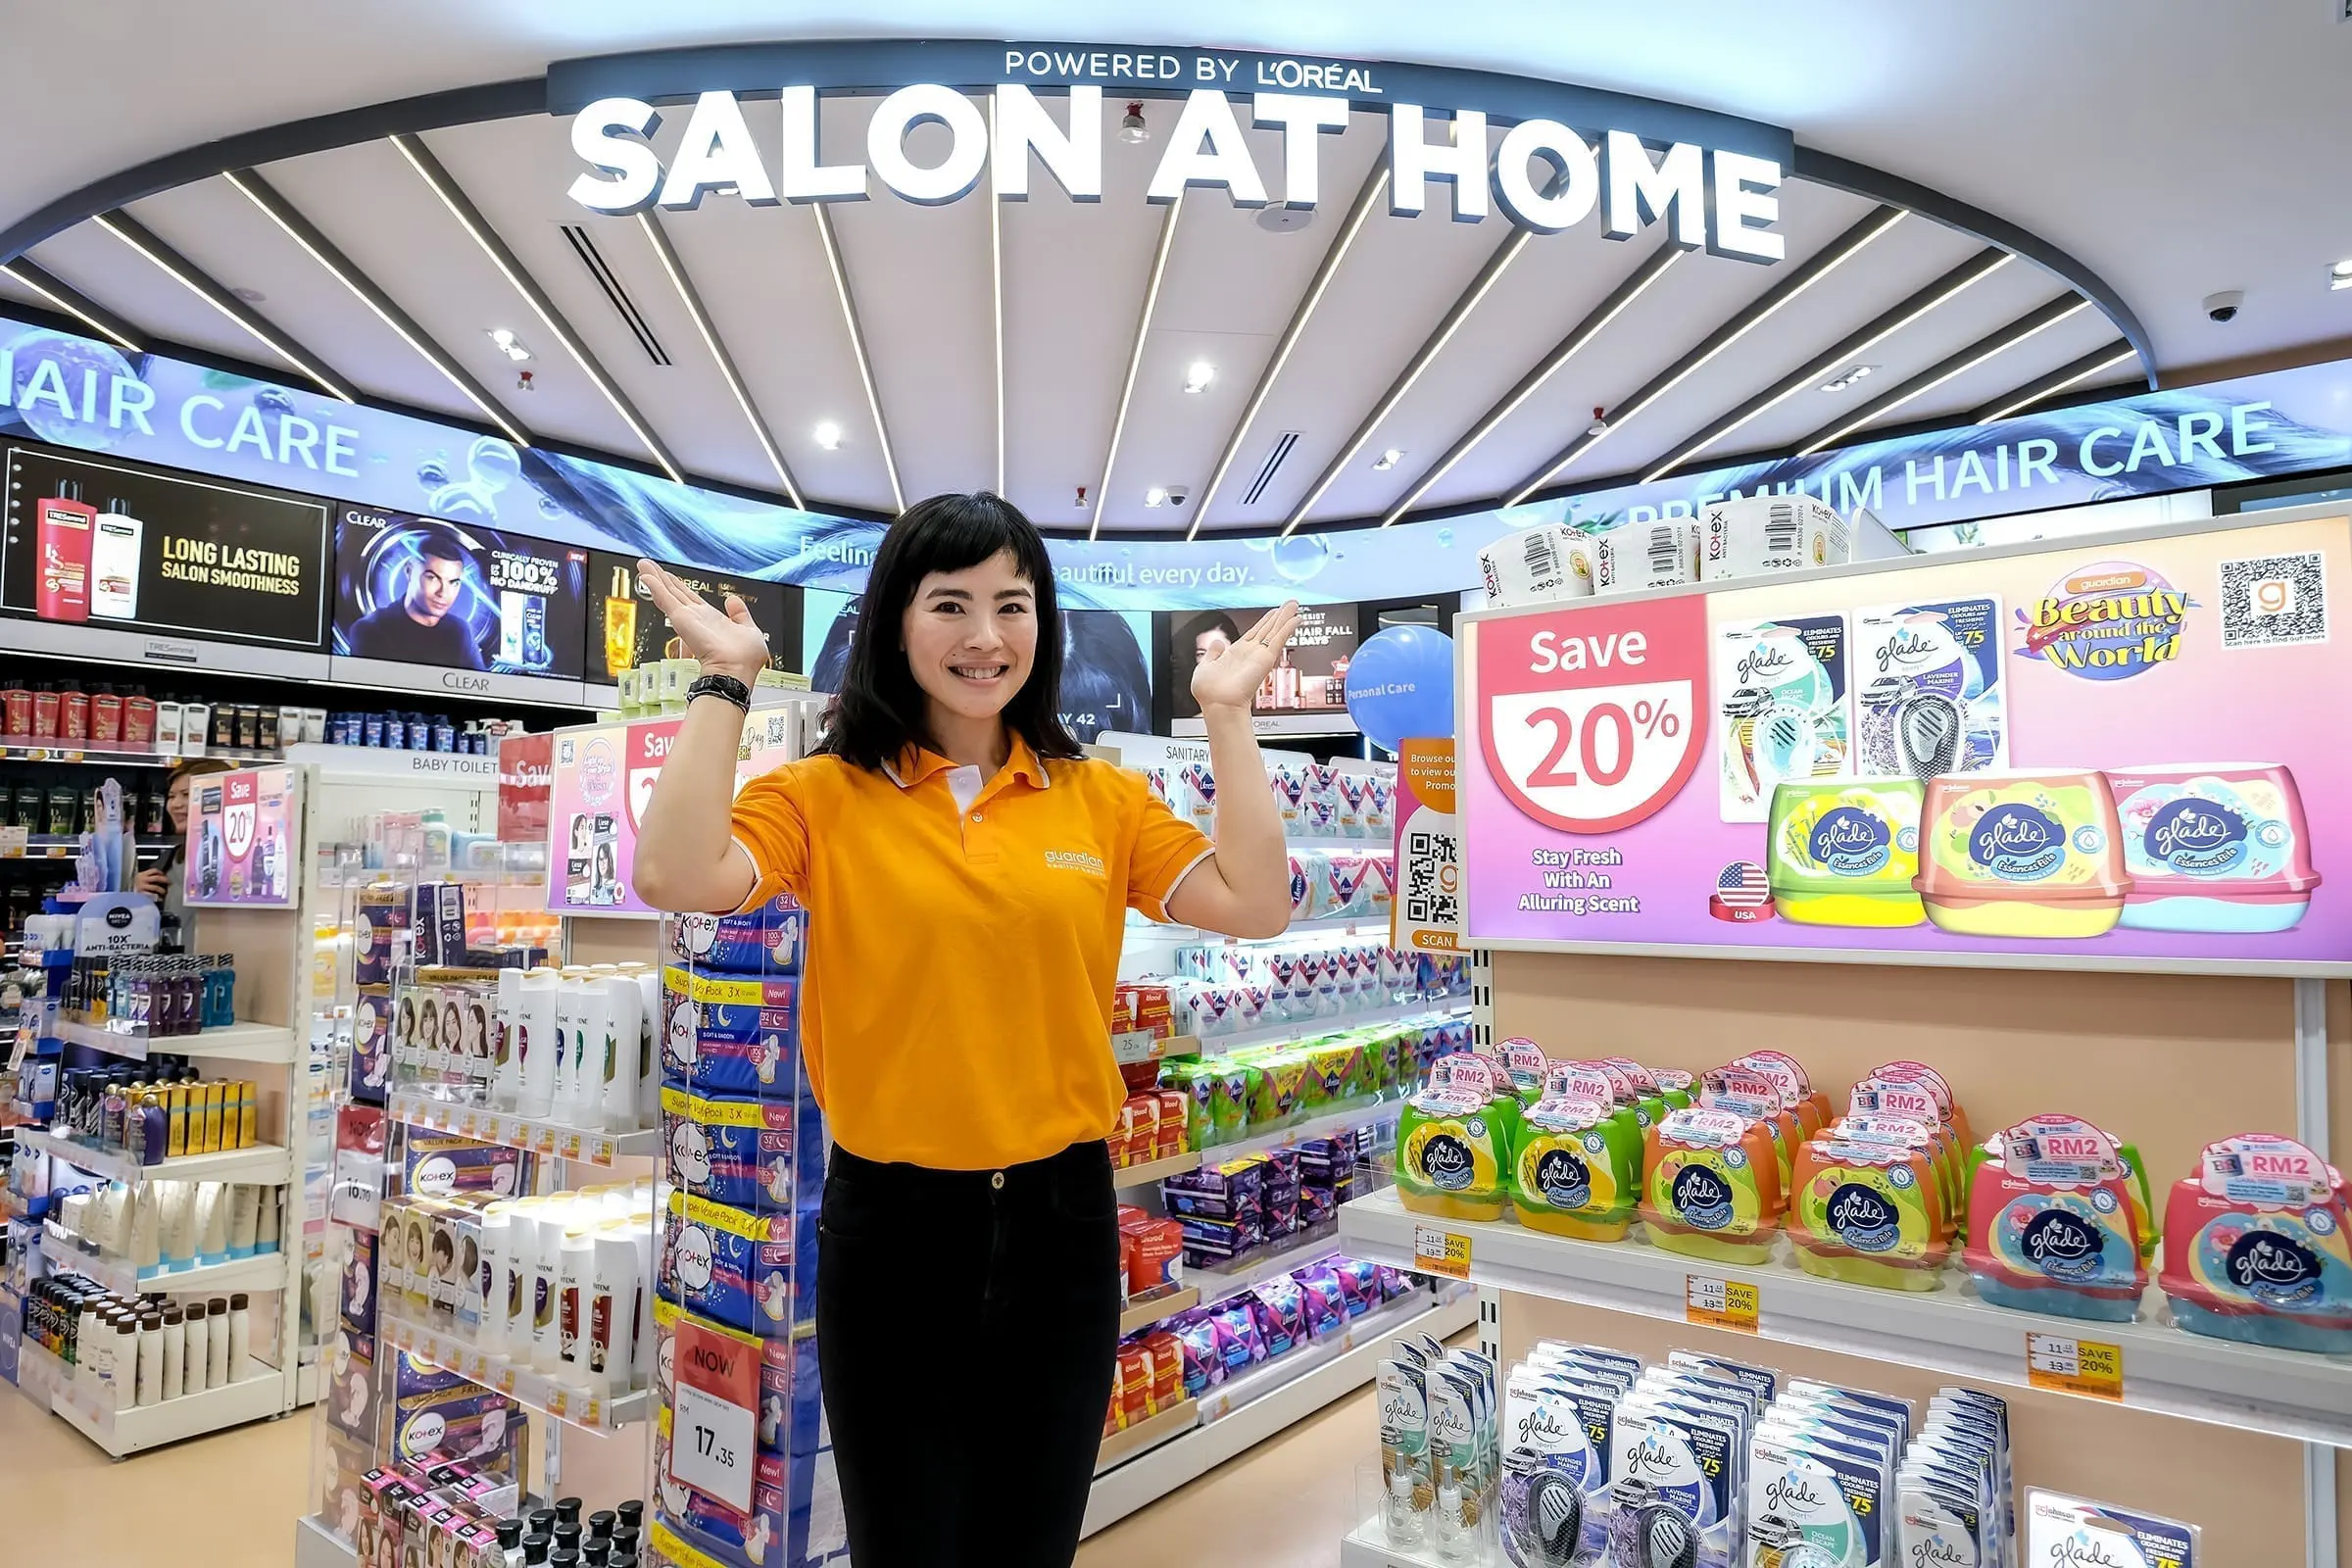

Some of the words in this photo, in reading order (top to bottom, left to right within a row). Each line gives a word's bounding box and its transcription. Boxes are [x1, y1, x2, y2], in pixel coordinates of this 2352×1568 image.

[1005, 51, 1181, 80] POWERED
[1196, 57, 1240, 81] BY
[1256, 59, 1384, 94] L'ORÉAL
[566, 82, 1102, 215] SALON
[1147, 88, 1349, 211] AT
[1389, 102, 1786, 267] HOME
[179, 394, 360, 478] CARE
[1628, 466, 1884, 524] PRUM
[1908, 436, 2059, 503] HAIR
[2079, 399, 2277, 478] CARE
[346, 511, 386, 530] CLEAR
[1709, 510, 1723, 562] Kotex
[163, 535, 218, 565] LONG
[221, 545, 300, 577] LASTING
[1598, 537, 1610, 588] Kotex
[162, 561, 209, 584] SALON
[210, 568, 300, 596] SMOOTHNESS
[500, 559, 558, 586] 100%
[1053, 563, 1134, 585] autiful
[1139, 566, 1201, 589] every
[1206, 561, 1255, 587] day.
[1481, 553, 1497, 599] Kotex
[2080, 574, 2132, 590] guardian
[2257, 580, 2286, 612] g
[1947, 603, 1991, 614] ELIMINATES
[2032, 586, 2190, 629] Beauty
[1295, 626, 1323, 637] HAIR
[1325, 625, 1353, 636] FALL
[1963, 629, 1986, 646] 75
[2058, 623, 2132, 643] around
[2133, 620, 2166, 637] the
[1298, 635, 1331, 646] DAYS
[1529, 629, 1647, 674] Save
[1816, 645, 1836, 659] 75
[1876, 633, 1939, 672] glade
[2043, 633, 2181, 670] World
[1737, 647, 1794, 684] glade
[442, 671, 490, 692] CLEAR
[1348, 683, 1386, 700] Personal
[1387, 682, 1416, 694] Care
[1076, 712, 1096, 725] 42
[643, 731, 678, 759] Sav
[1524, 698, 1680, 788] 20%
[1166, 745, 1210, 763] SANITARY
[1410, 753, 1444, 763] Browse
[413, 757, 449, 771] BABY
[452, 760, 498, 775] TOILET
[515, 760, 552, 789] Sav
[1410, 767, 1420, 776] to
[1420, 766, 1443, 777] view
[230, 780, 251, 800] Save
[1817, 821, 1879, 859] glade
[1980, 818, 2051, 860] glade
[2156, 813, 2232, 856] glade
[1044, 850, 1104, 870] guardian
[1532, 849, 1570, 868] Stay
[1572, 848, 1623, 866] Fresh
[1996, 860, 2038, 874] Essences
[2036, 852, 2058, 868] Elite
[2174, 855, 2219, 869] Essences
[1544, 870, 1584, 889] With
[1585, 871, 1611, 889] An
[779, 895, 789, 905] 32
[1518, 893, 1587, 915] Alluring
[1587, 894, 1641, 913] Scent
[1734, 909, 1757, 921] USA
[85, 943, 150, 952] ANTI-BACTERIA
[108, 934, 128, 944] 10X
[1421, 933, 1452, 947] SCAN
[767, 988, 786, 1000] New!
[1145, 992, 1161, 1003] blood
[1513, 1054, 1541, 1067] RM2
[1455, 1069, 1485, 1084] RM2
[1446, 1094, 1475, 1103] RM2
[1572, 1081, 1605, 1098] RM2
[1732, 1083, 1768, 1097] RM2
[1132, 1106, 1149, 1118] blood
[1163, 1098, 1178, 1109] blood
[1560, 1105, 1594, 1115] RM2
[1886, 1095, 1927, 1111] RM2
[1697, 1116, 1736, 1130] RM2
[1874, 1123, 1918, 1134] RM2
[2047, 1138, 2099, 1155] RM2
[1426, 1150, 1465, 1173] glade
[2252, 1155, 2310, 1175] RM2
[419, 1170, 454, 1183] Kotex
[1541, 1162, 1581, 1189] glade
[1677, 1180, 1723, 1208] glade
[1834, 1199, 1887, 1229] glade
[1445, 1238, 1466, 1250] SAVE
[2030, 1222, 2091, 1260] glade
[1445, 1247, 1465, 1260] 20%
[2235, 1247, 2307, 1285] glade
[1726, 1287, 1753, 1299] SAVE
[1728, 1298, 1752, 1311] 20%
[694, 1345, 735, 1378] NOW
[1157, 1350, 1173, 1362] blood
[2078, 1347, 2114, 1361] SAVE
[1125, 1360, 1141, 1373] blood
[2081, 1358, 2113, 1375] 20%
[1739, 1370, 1772, 1384] ELIMINATES
[679, 1402, 690, 1416] RM
[1384, 1398, 1423, 1423] glade
[1578, 1398, 1612, 1412] ELIMINATES
[1433, 1410, 1470, 1437] glade
[1518, 1411, 1569, 1444] glade
[408, 1425, 443, 1442] Kotex
[1589, 1425, 1605, 1442] 75
[1690, 1428, 1727, 1444] ELIMINATES
[695, 1425, 735, 1468] 17.35
[1553, 1454, 1583, 1467] LAVENDER
[1627, 1441, 1681, 1475] glade
[1702, 1457, 1721, 1474] 75
[760, 1463, 780, 1478] New!
[1838, 1472, 1880, 1490] ELIMINATES
[1665, 1487, 1696, 1500] LAVENDER
[1669, 1494, 1692, 1505] MARINE
[1766, 1476, 1827, 1510] glade
[1850, 1494, 1873, 1513] 75
[1811, 1530, 1836, 1543] OCEAN
[2136, 1531, 2189, 1550] ELIMINATES
[1912, 1538, 1973, 1568] glade
[2050, 1536, 2124, 1568] glade
